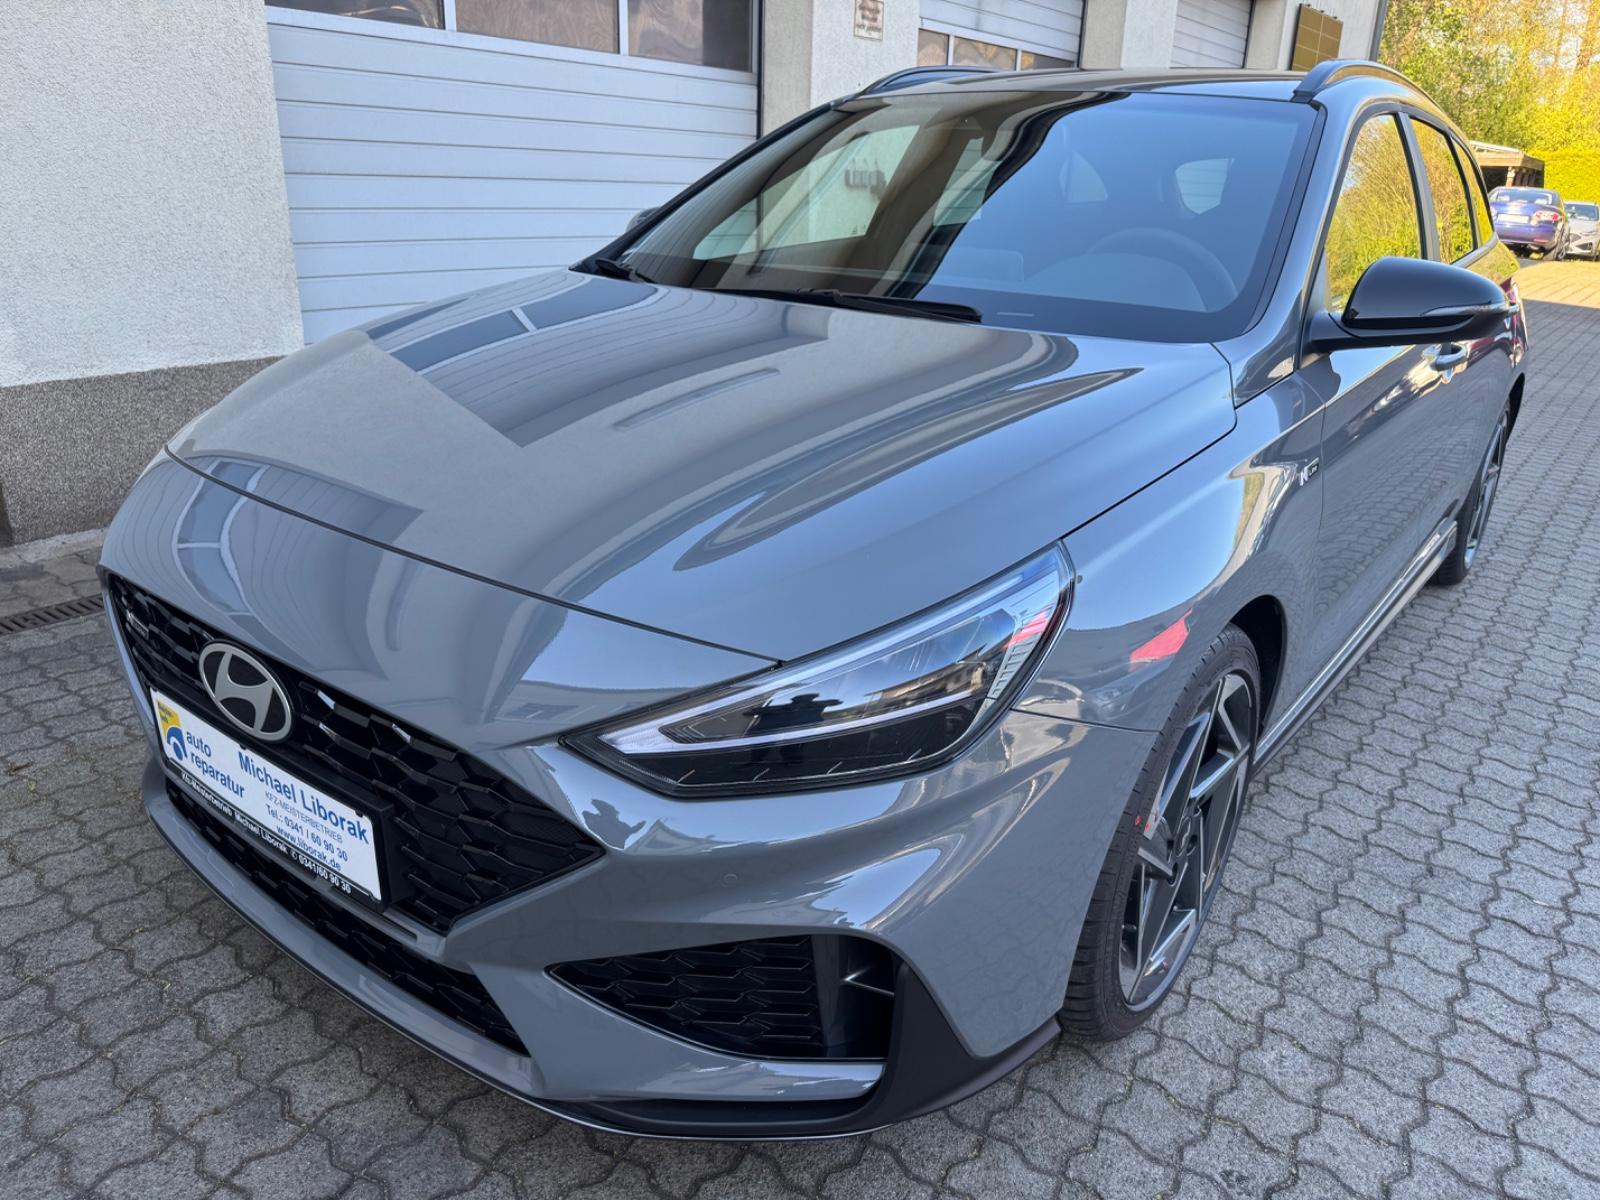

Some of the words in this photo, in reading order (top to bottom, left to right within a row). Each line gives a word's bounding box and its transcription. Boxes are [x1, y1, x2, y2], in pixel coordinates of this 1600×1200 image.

[186, 731, 212, 757] auto
[190, 752, 245, 798] reparatur
[238, 751, 297, 803] Michael
[300, 789, 370, 844] Liborak
[260, 828, 289, 854] Liborak
[265, 803, 283, 823] Tel.:
[284, 816, 304, 836] 0341
[311, 832, 322, 847] 60
[323, 839, 335, 854] 90
[336, 847, 348, 862] 30
[276, 825, 342, 871] www.liborak.de
